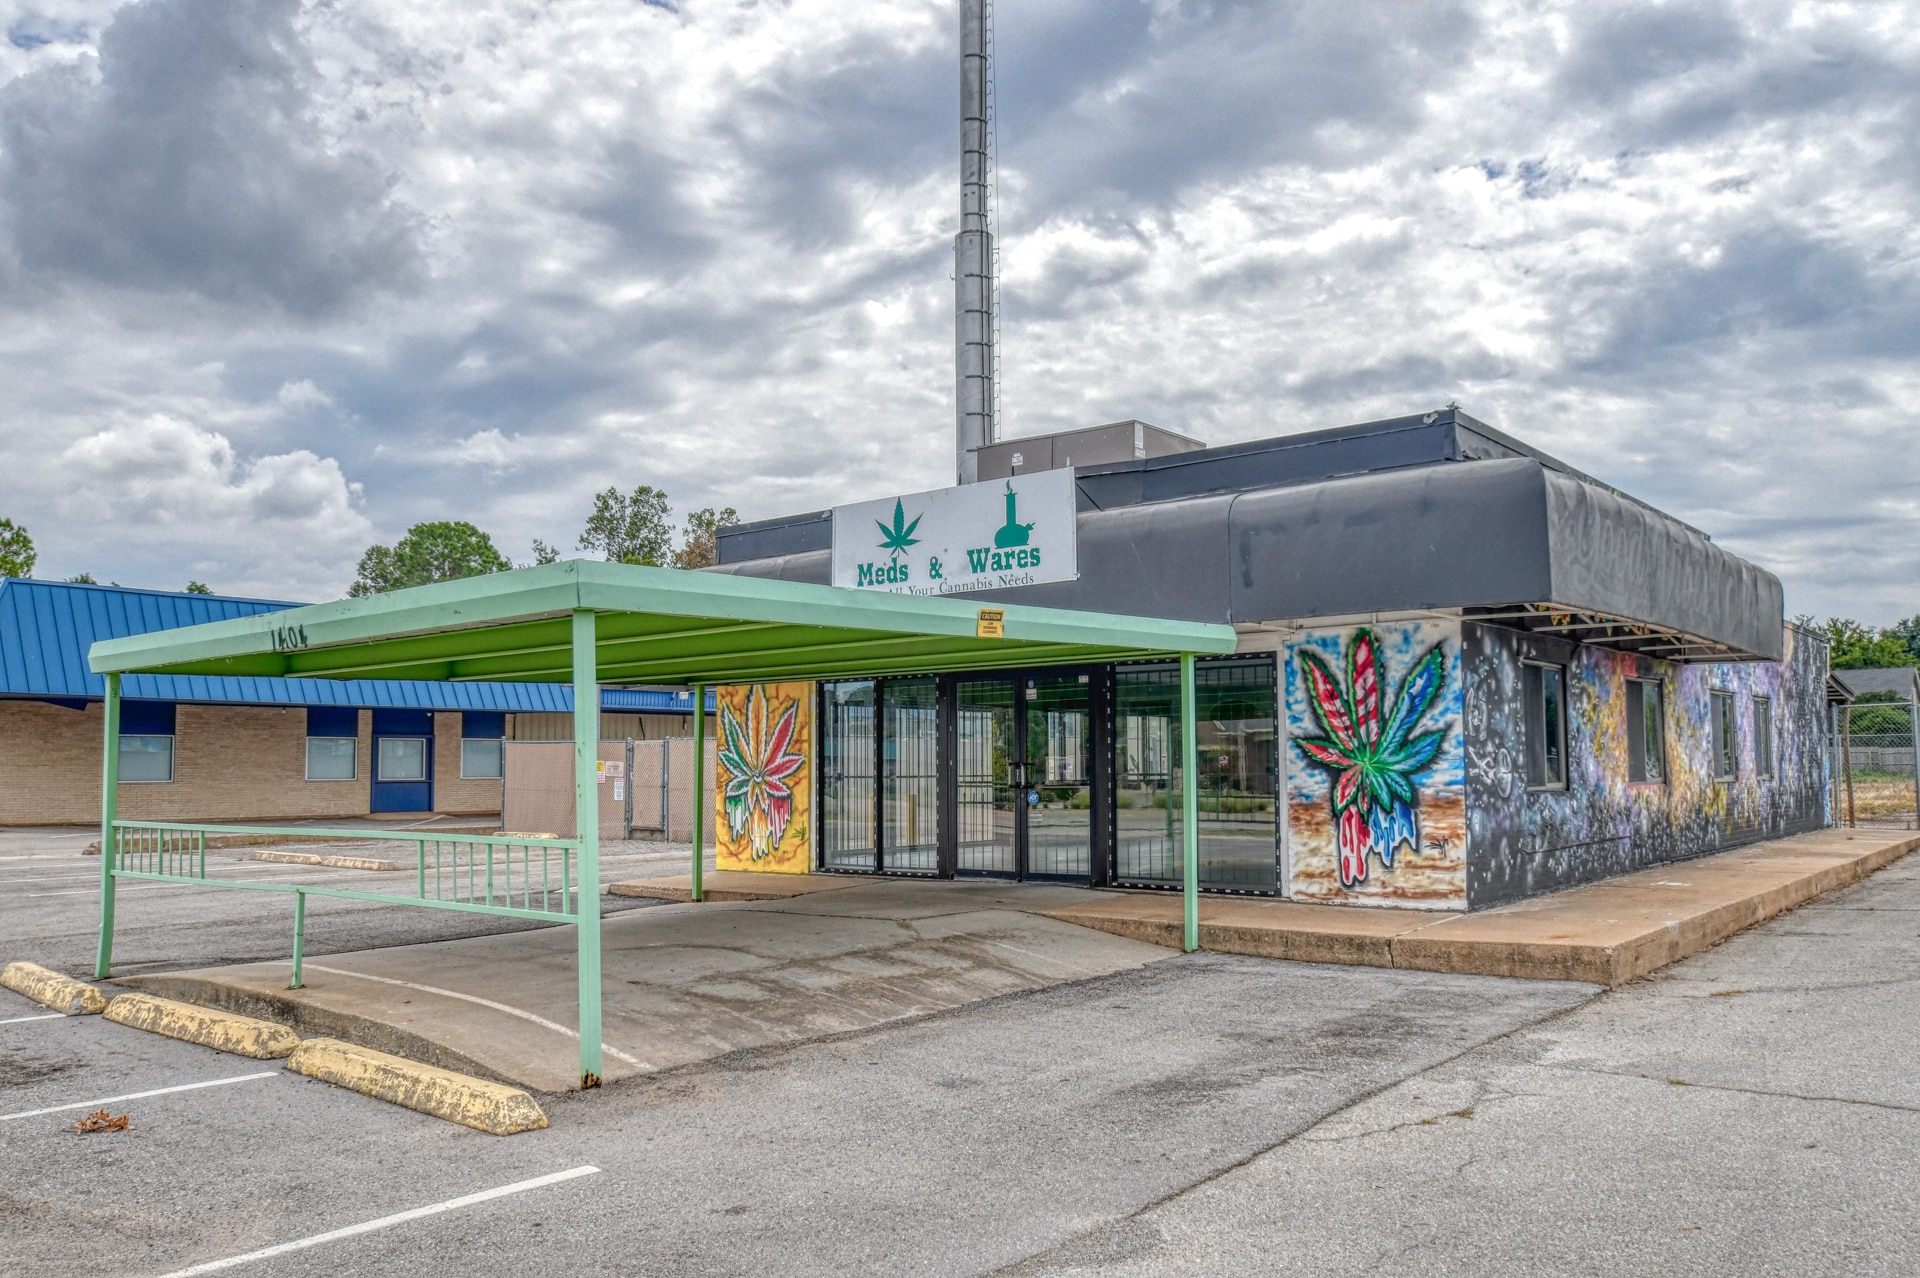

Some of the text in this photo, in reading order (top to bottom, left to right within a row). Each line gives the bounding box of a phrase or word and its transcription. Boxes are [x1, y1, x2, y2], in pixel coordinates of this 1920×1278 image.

[857, 547, 1041, 587] Meds & Wares
[908, 585, 934, 596] Your
[939, 577, 993, 593] Cannabis
[998, 573, 1034, 587] Needs
[981, 612, 1001, 621] CAUTION
